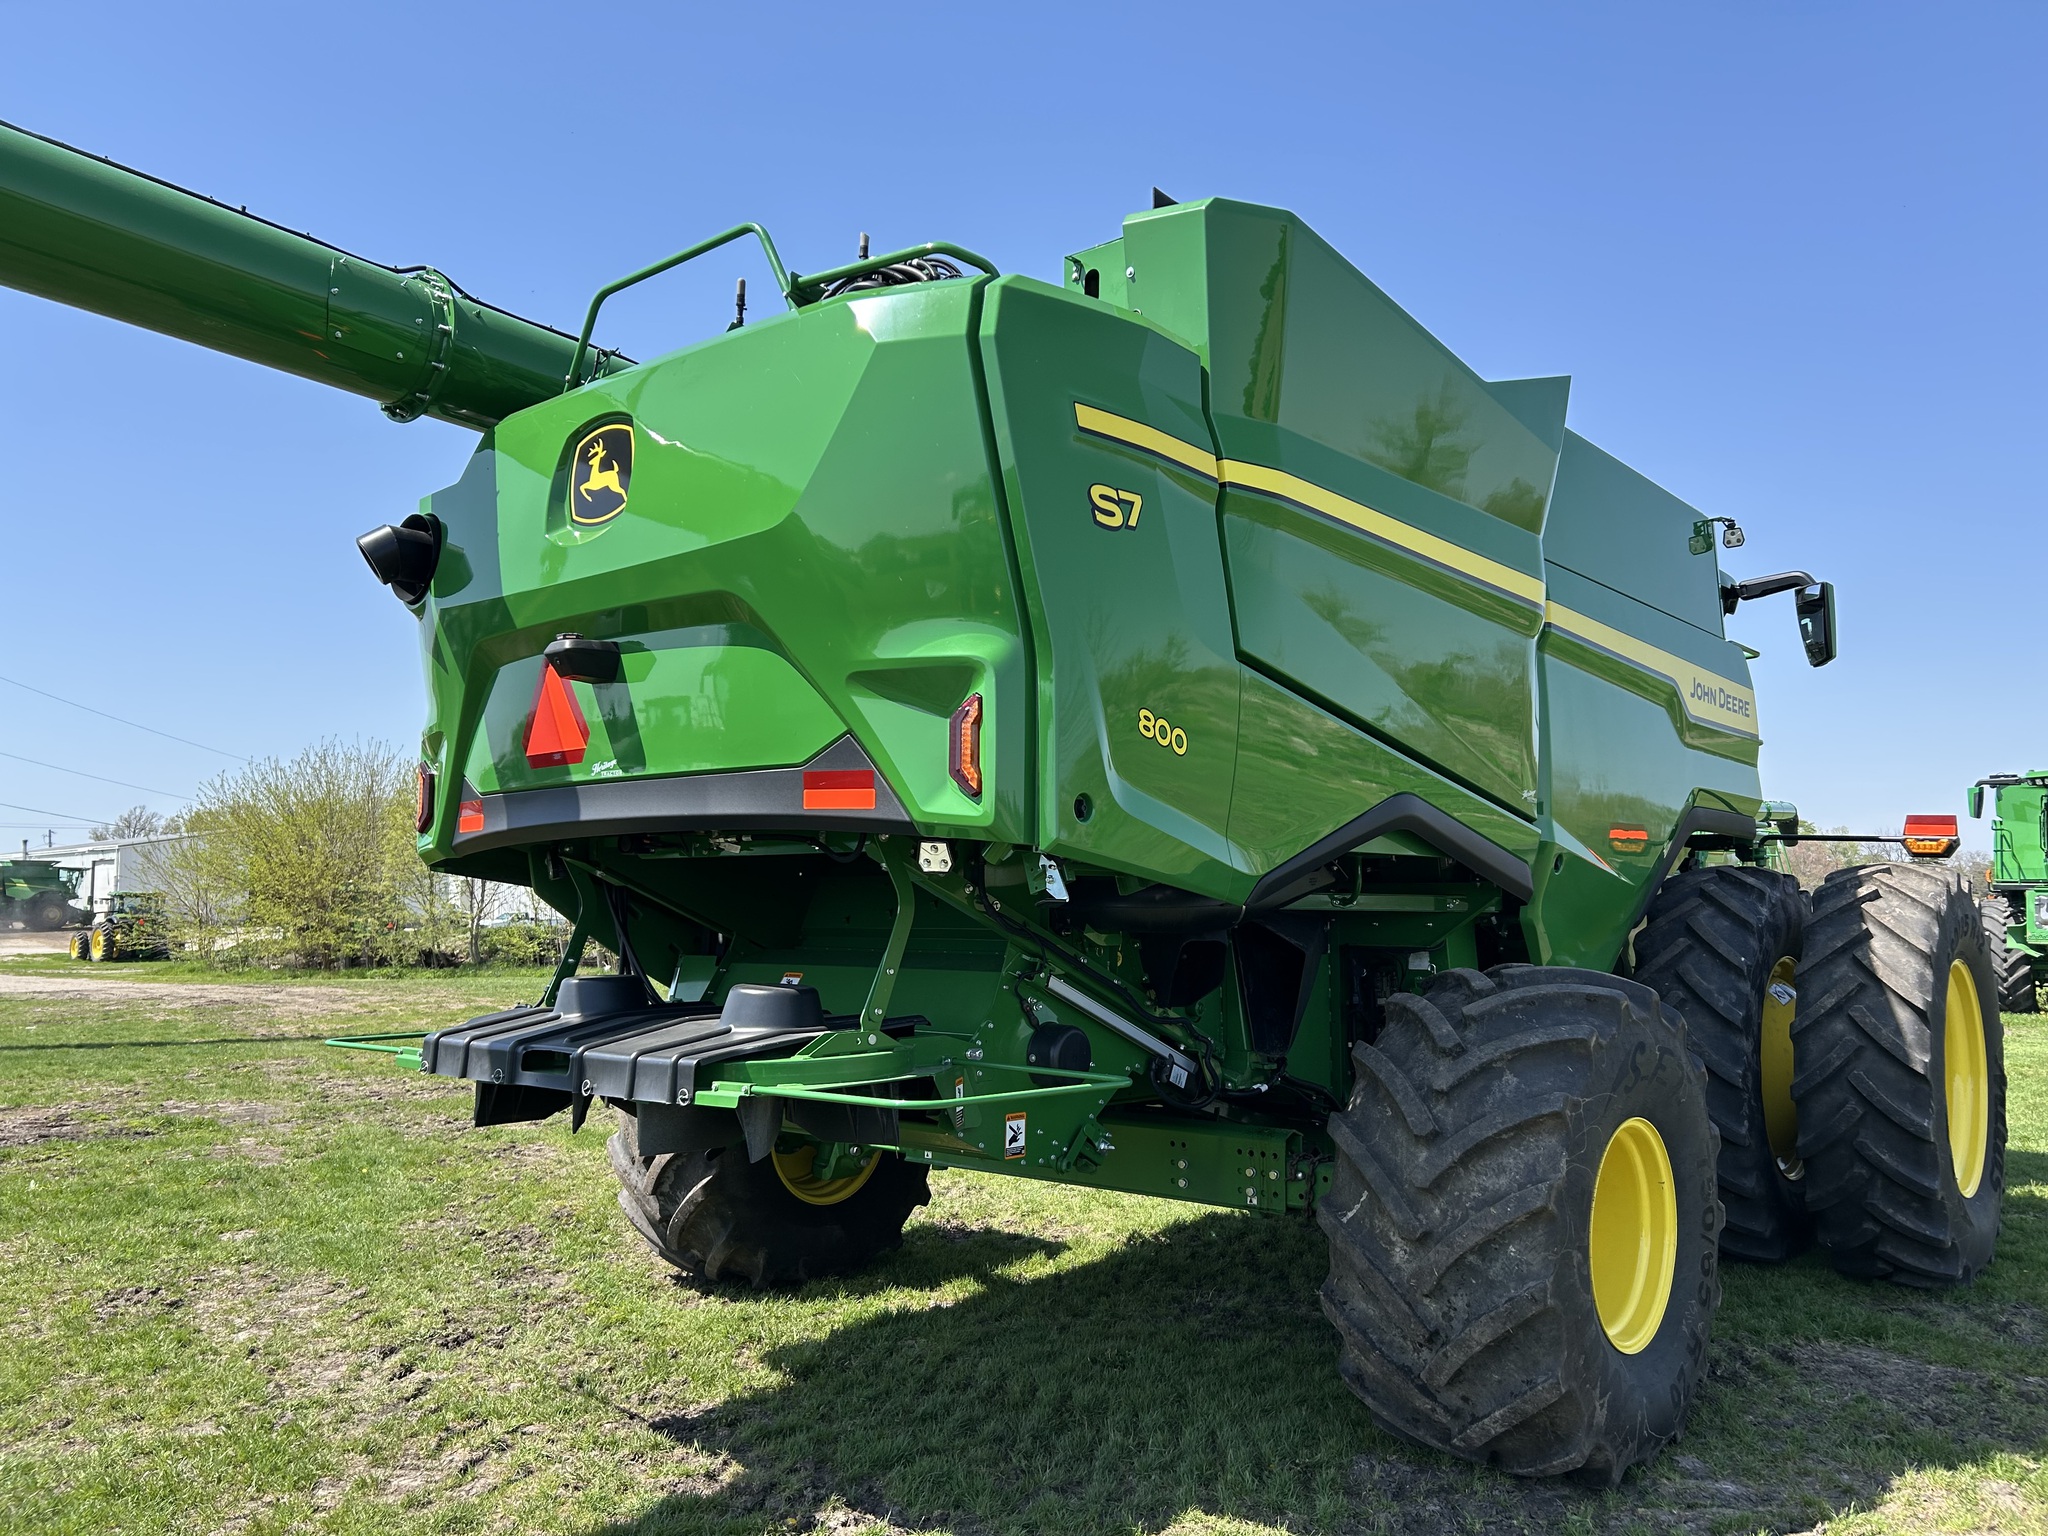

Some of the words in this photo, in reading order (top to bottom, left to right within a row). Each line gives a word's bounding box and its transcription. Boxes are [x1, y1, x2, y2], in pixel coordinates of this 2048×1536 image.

[1088, 483, 1143, 531] S7
[1690, 677, 1717, 706] JOHN
[1718, 687, 1750, 718] DEERE
[1138, 707, 1188, 757] 800
